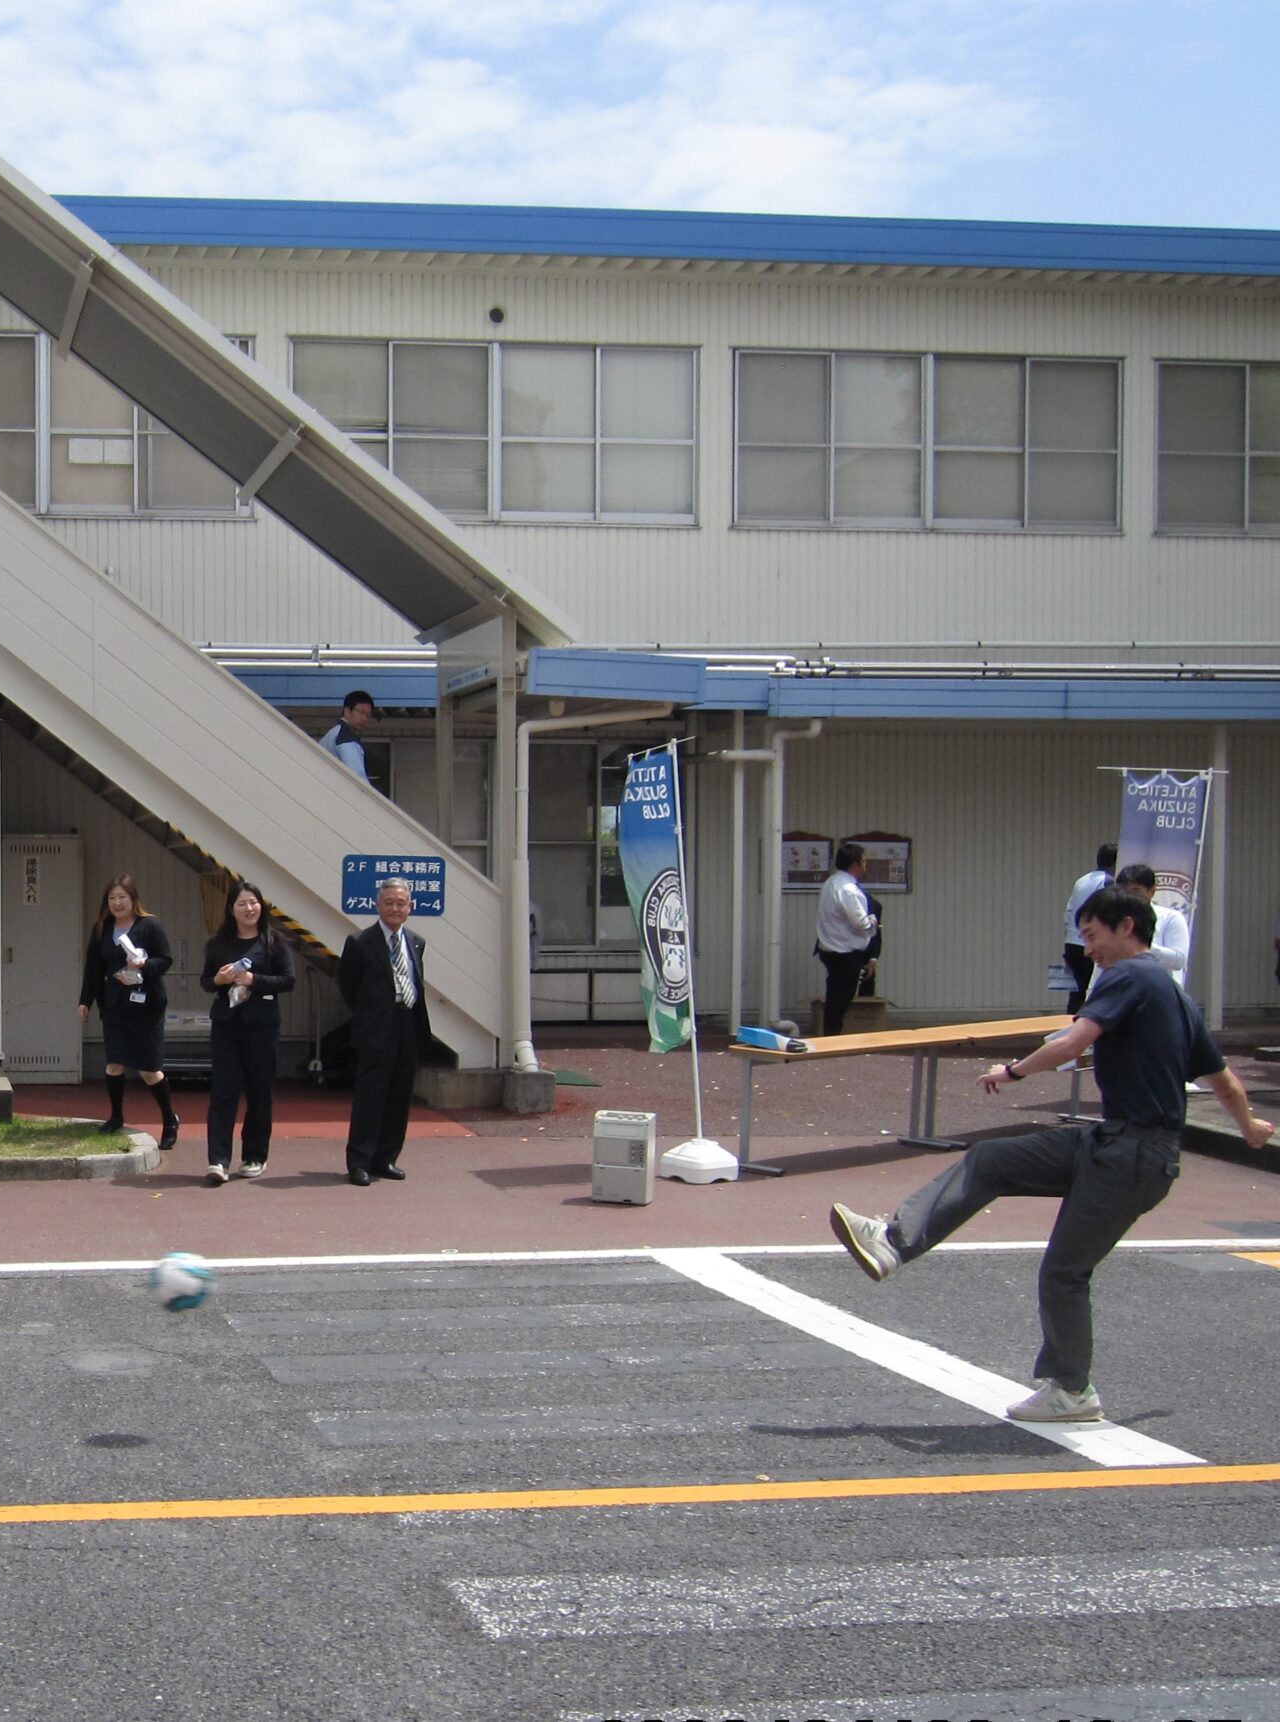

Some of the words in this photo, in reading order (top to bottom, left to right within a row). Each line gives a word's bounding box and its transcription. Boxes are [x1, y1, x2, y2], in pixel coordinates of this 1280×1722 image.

[375, 861, 440, 874] 組合事務所
